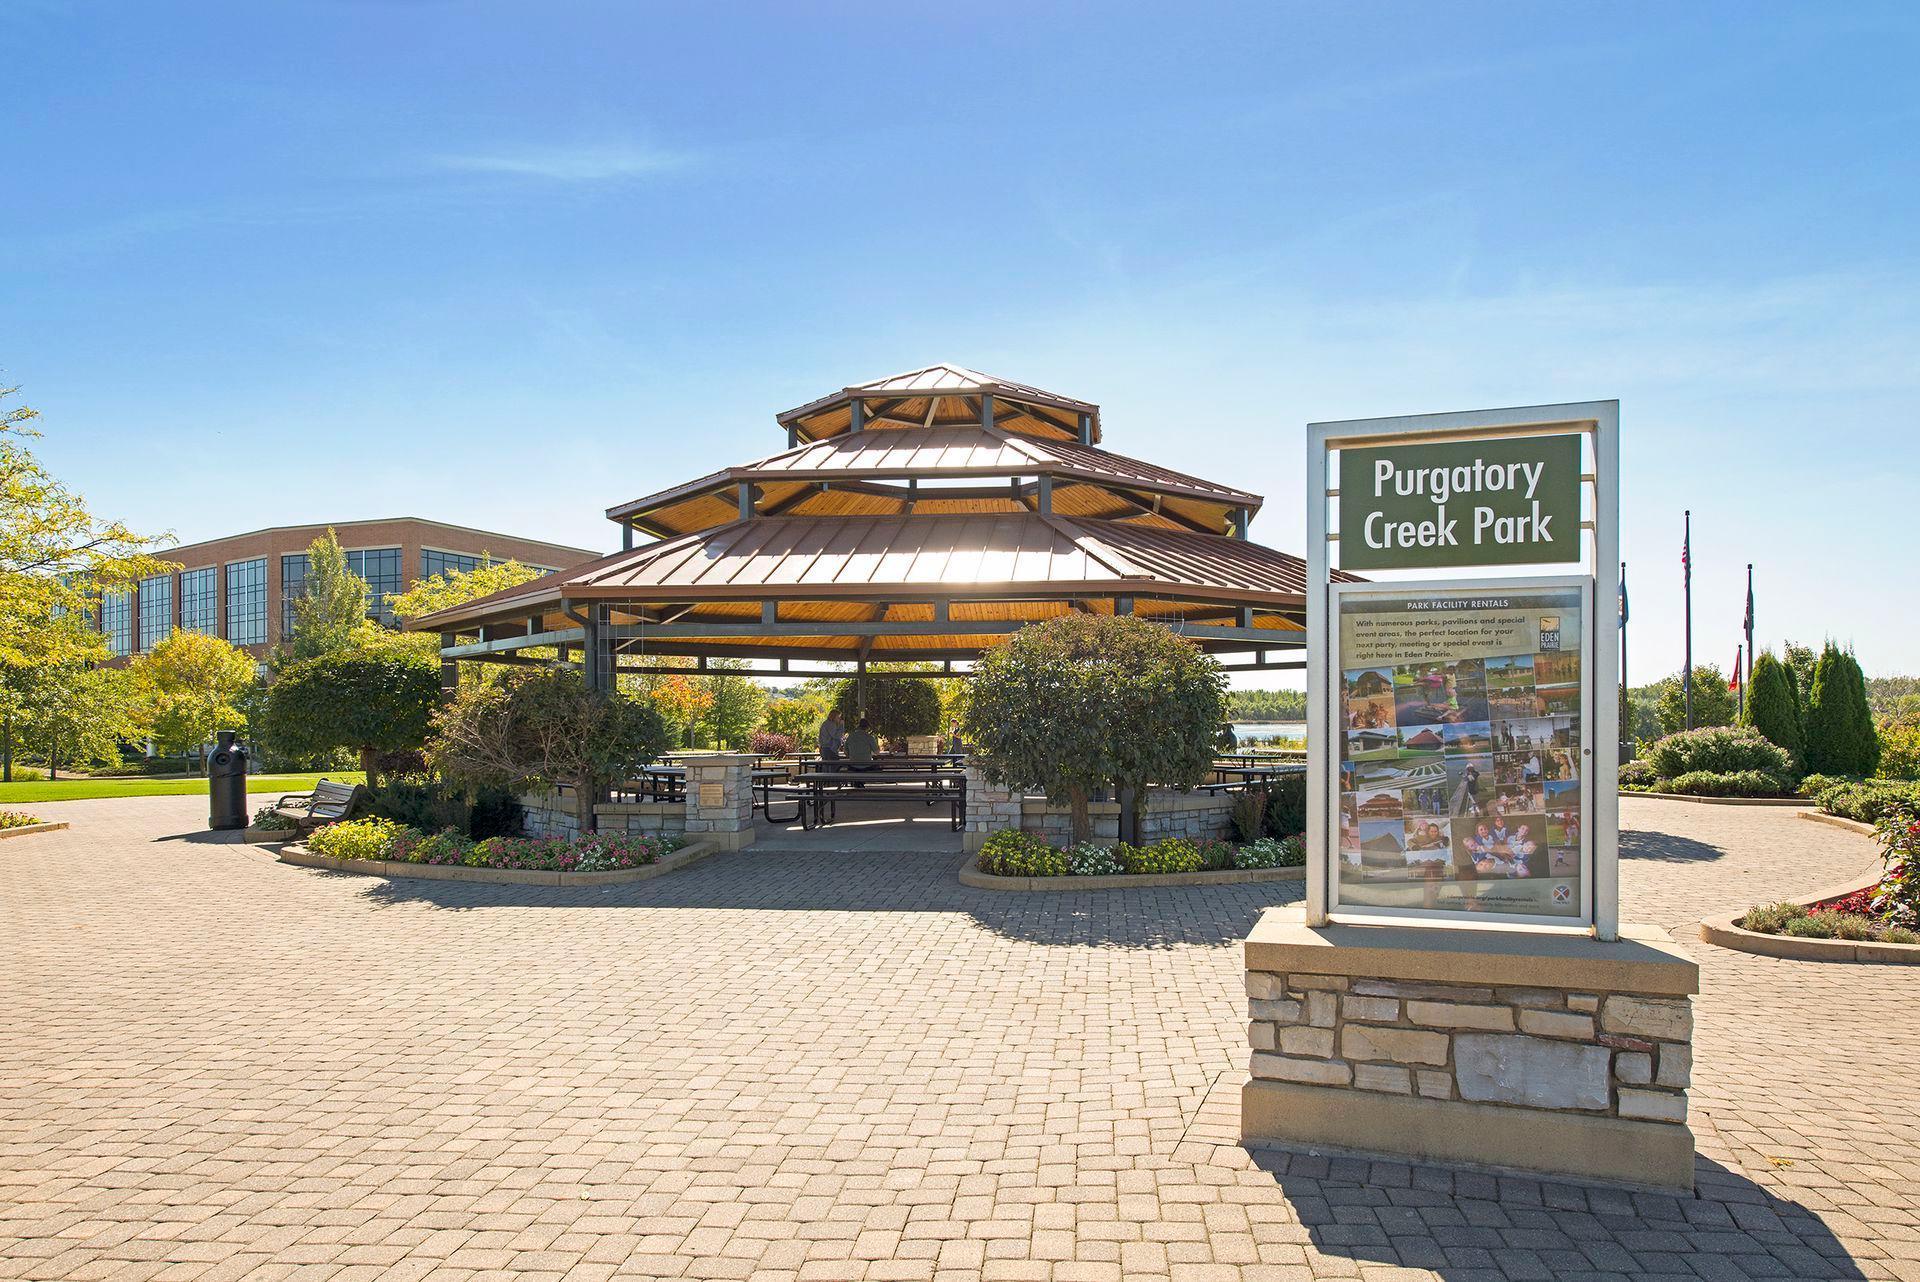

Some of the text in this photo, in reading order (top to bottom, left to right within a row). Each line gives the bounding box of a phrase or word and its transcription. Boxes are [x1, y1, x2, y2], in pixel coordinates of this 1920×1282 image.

[1374, 458, 1545, 504] Purgatory
[1364, 500, 1554, 549] Creek Park
[1407, 599, 1509, 610] PARK FACILITY RENTALS
[1415, 619, 1440, 628] parks,
[1442, 617, 1477, 627] pavilions
[1498, 616, 1525, 626] special
[1418, 629, 1446, 638] perfect
[1447, 629, 1479, 637] location
[1540, 632, 1560, 642] EDEN
[1375, 641, 1397, 649] party,
[1399, 641, 1430, 649] meeting
[1443, 639, 1470, 648] special
[1540, 641, 1560, 649] PRAIRIE
[1356, 652, 1374, 660] right
[1376, 651, 1393, 659] here
[1425, 650, 1453, 658] Prairie.
